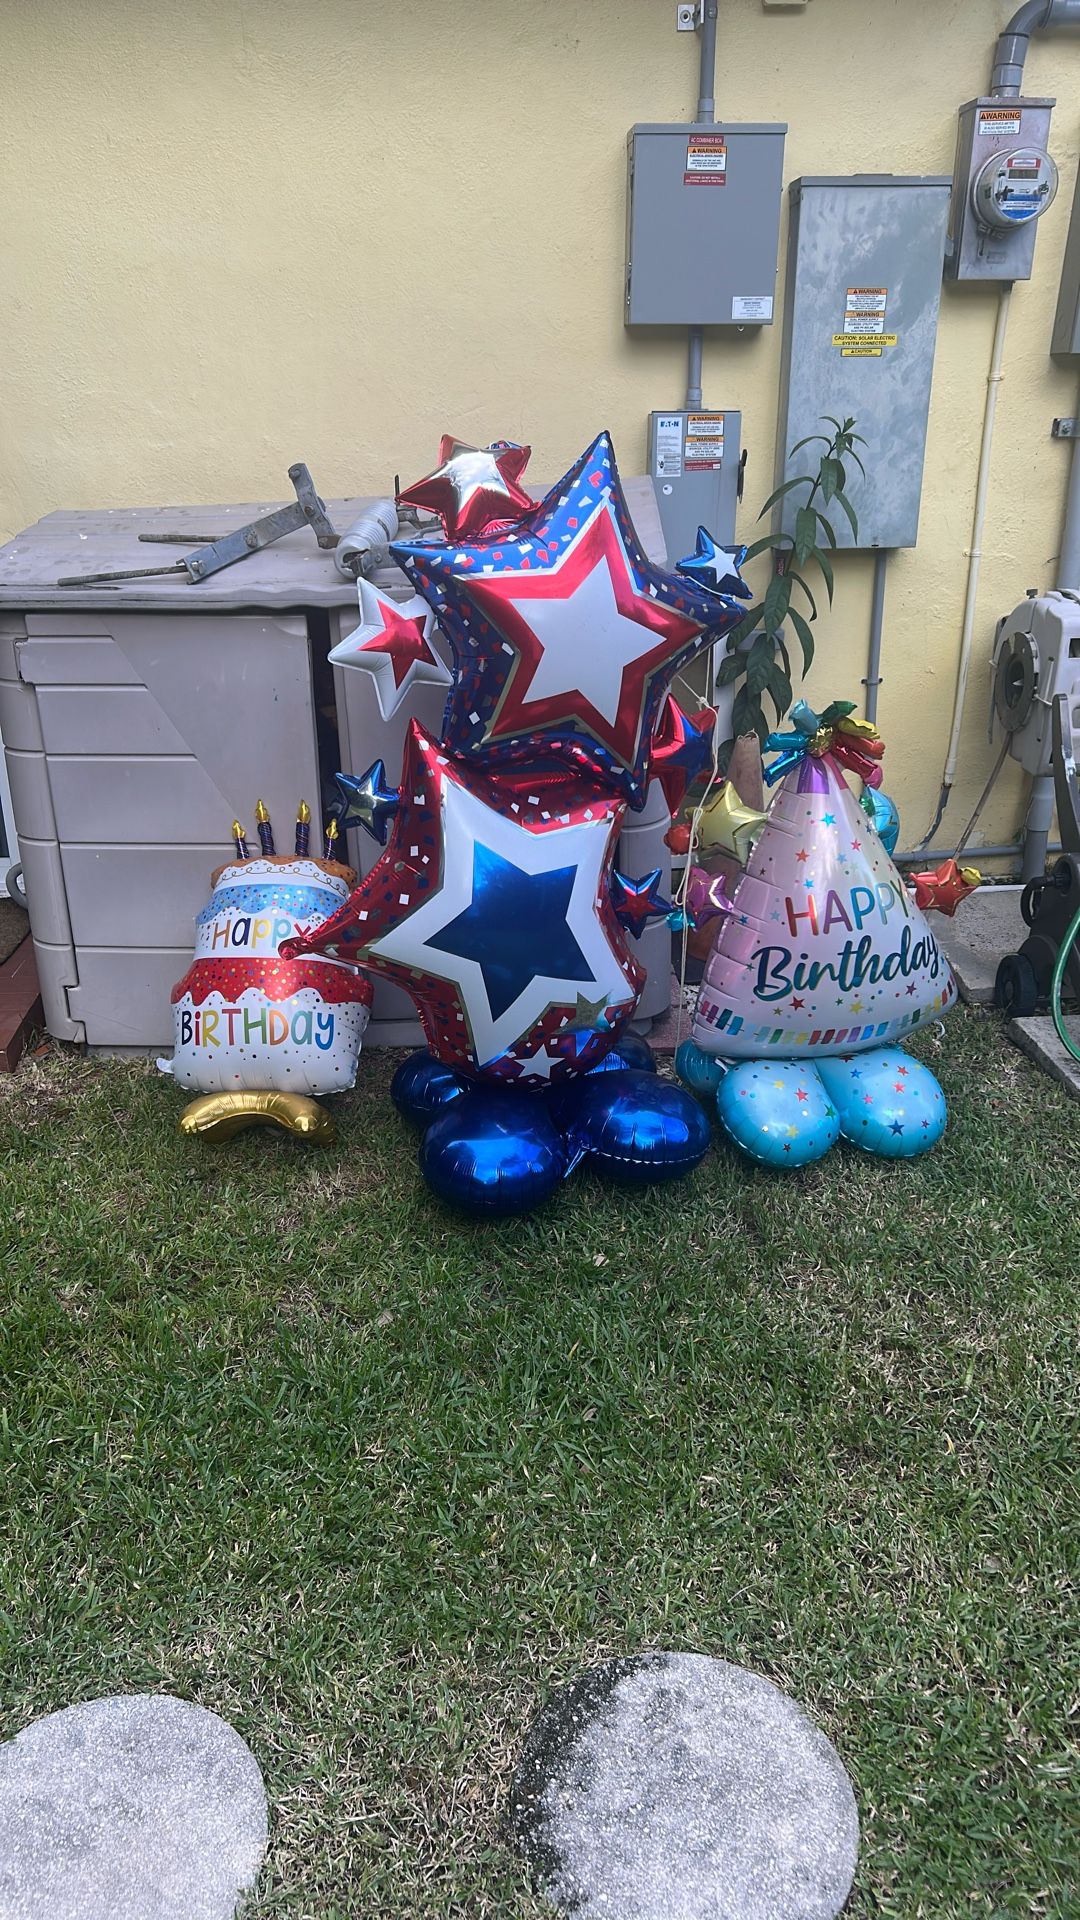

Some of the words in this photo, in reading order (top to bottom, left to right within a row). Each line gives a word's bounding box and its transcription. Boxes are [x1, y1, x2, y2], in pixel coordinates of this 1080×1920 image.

[986, 111, 1020, 119] WARNING
[785, 878, 909, 938] HAPPY
[751, 924, 939, 1002] Birthday
